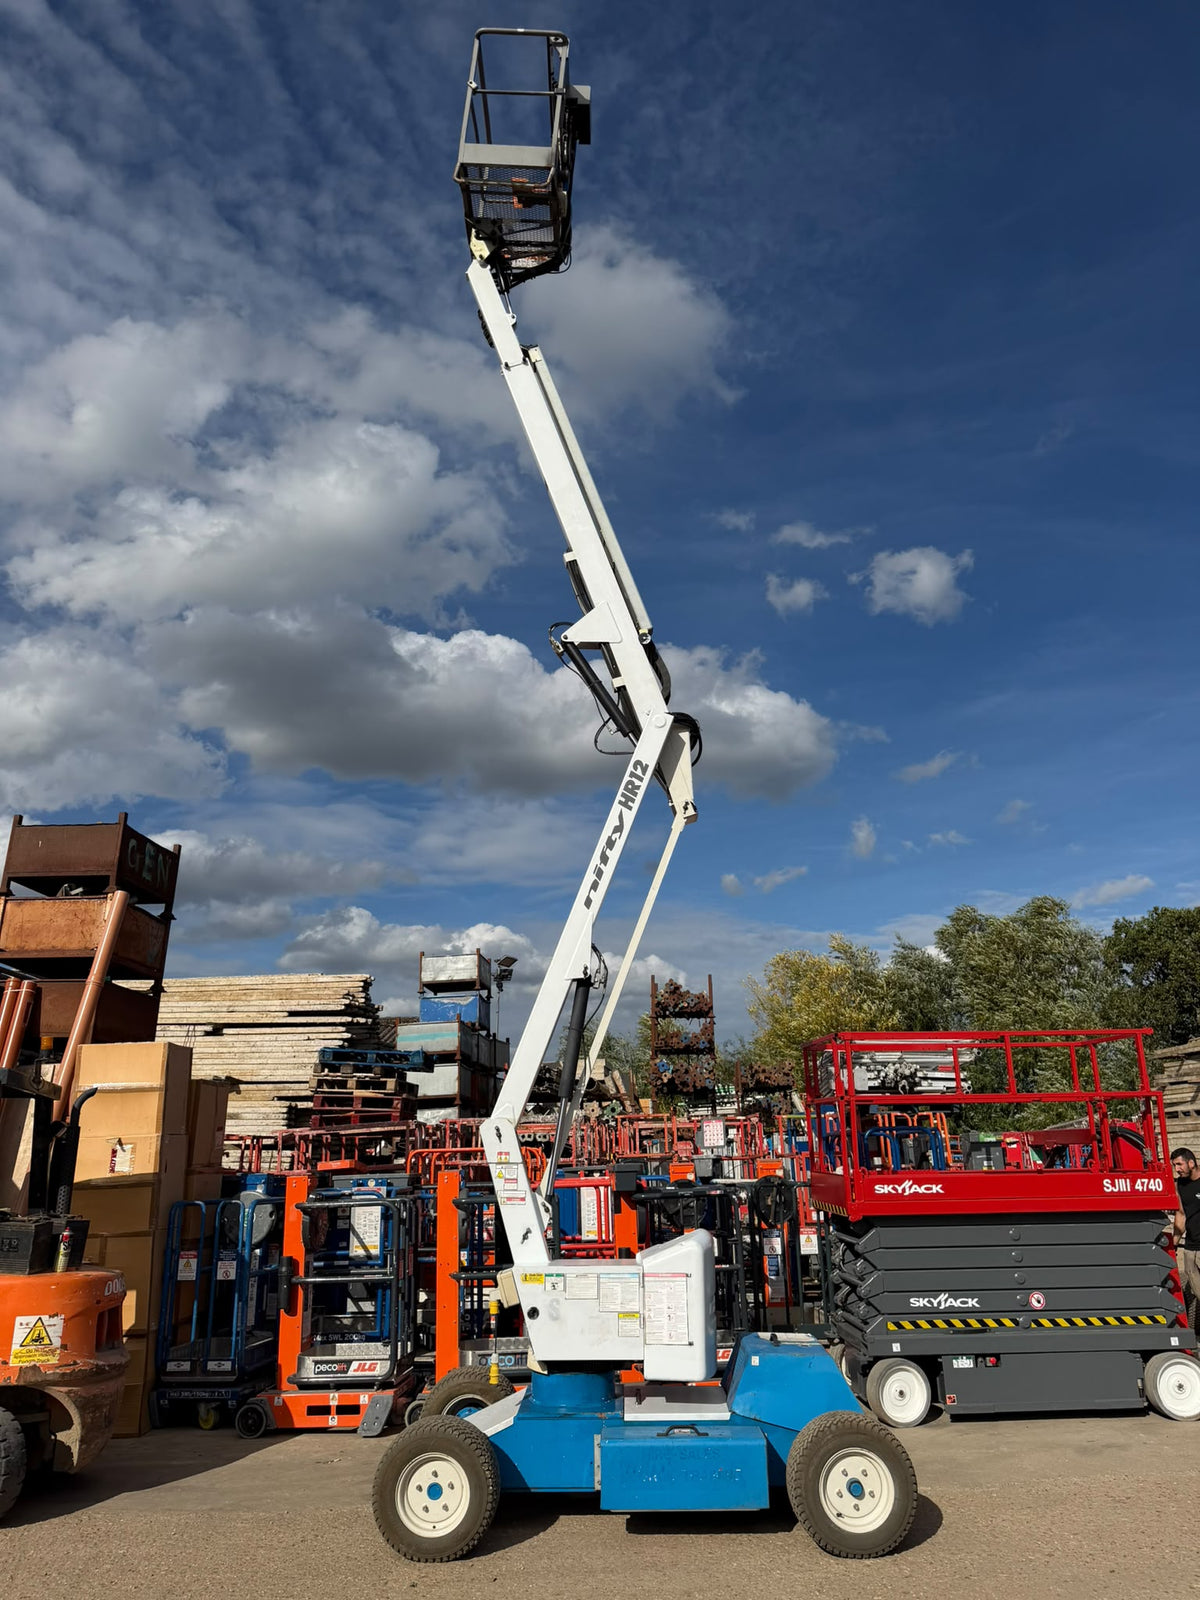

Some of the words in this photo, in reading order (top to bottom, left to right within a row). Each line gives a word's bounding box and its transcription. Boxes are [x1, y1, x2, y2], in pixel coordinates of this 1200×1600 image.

[618, 759, 650, 811] HR12
[128, 838, 171, 889] GEN
[584, 808, 625, 910] nifty
[874, 1179, 945, 1196] SKYJACK
[1103, 1179, 1131, 1192] SJIII
[1135, 1178, 1163, 1192] 4740
[909, 1292, 980, 1310] SKYJACK
[716, 1350, 732, 1360] LG
[315, 1362, 347, 1374] pecolift
[352, 1362, 379, 1373] JLG
